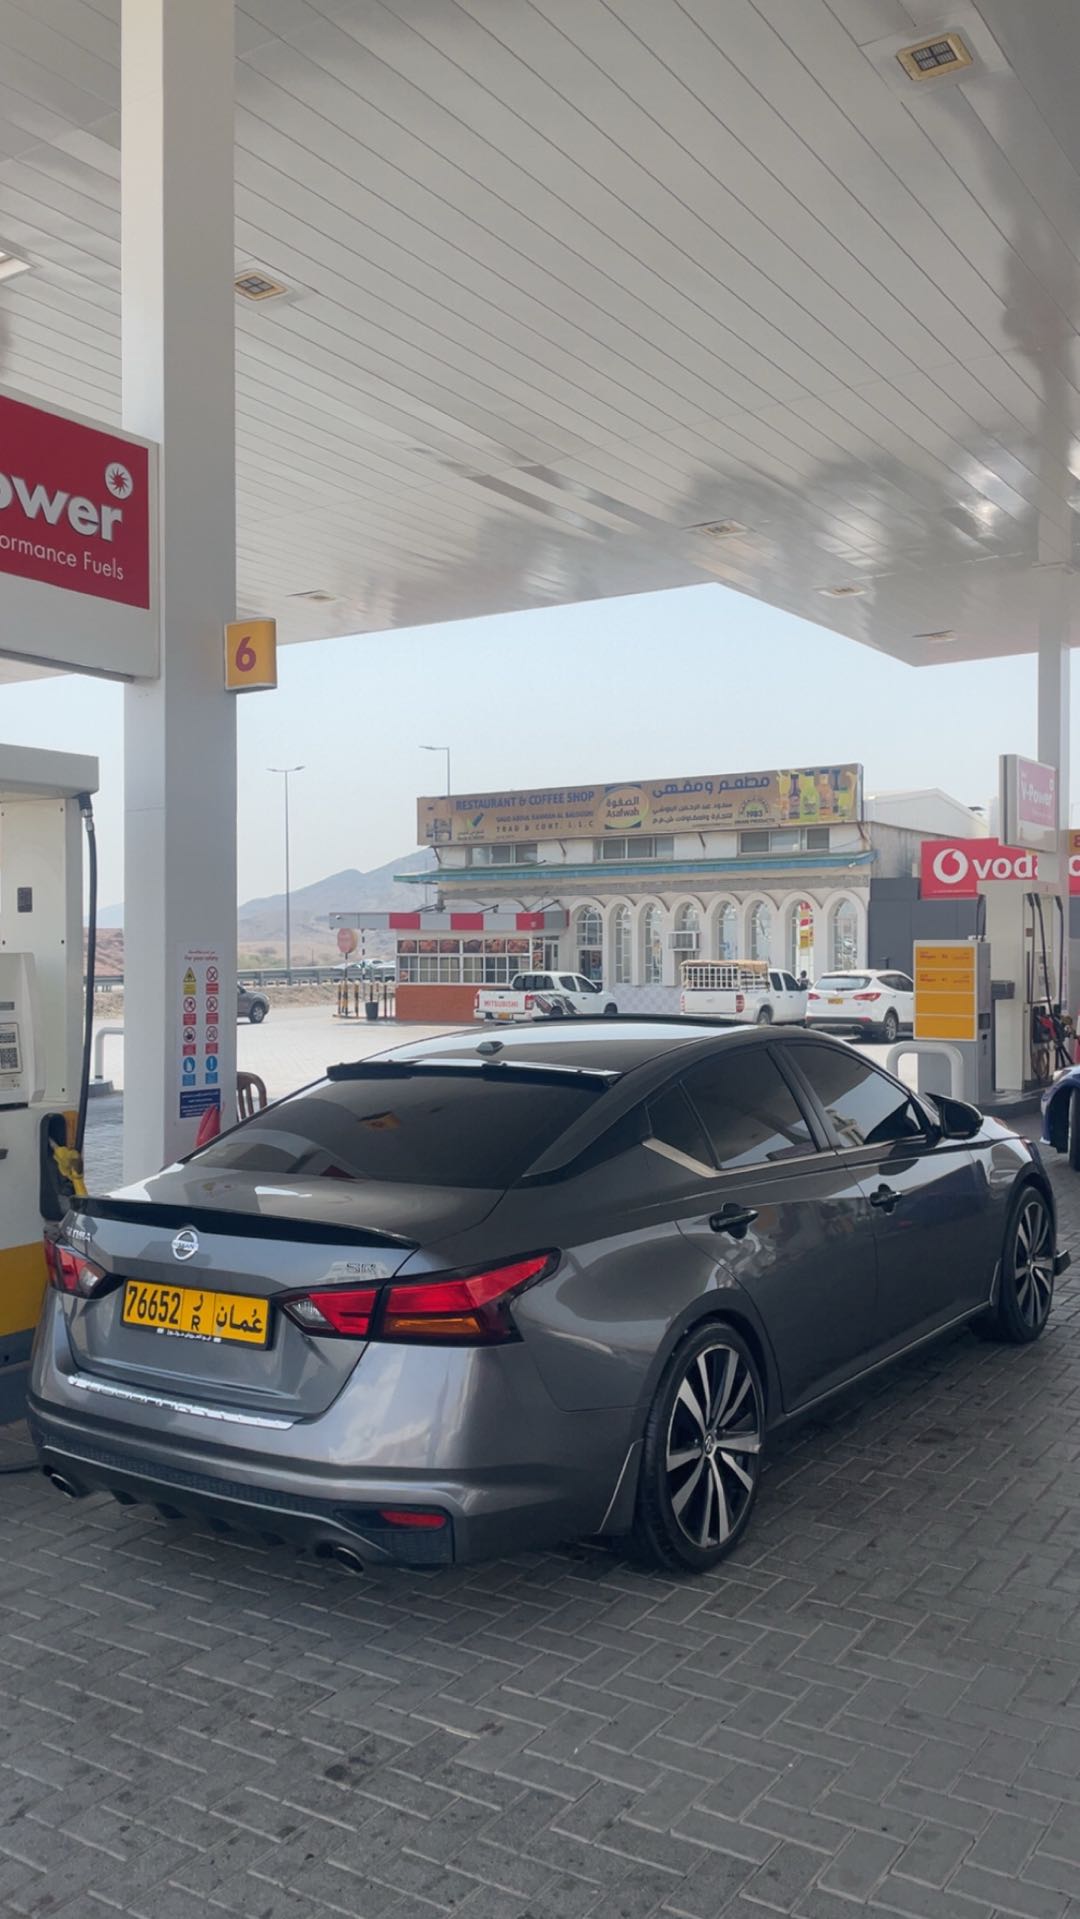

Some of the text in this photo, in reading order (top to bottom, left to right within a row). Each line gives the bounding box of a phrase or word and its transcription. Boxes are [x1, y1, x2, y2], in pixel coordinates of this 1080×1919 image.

[83, 551, 124, 580] Fuels
[235, 636, 256, 672] 6
[718, 776, 770, 794] مطعم
[455, 797, 516, 811] RESTAURANT
[528, 793, 565, 806] COFFEE
[567, 790, 595, 804] SHOP
[972, 854, 1080, 879] vodo
[126, 1285, 181, 1325] 76652
[191, 1315, 201, 1331] R
